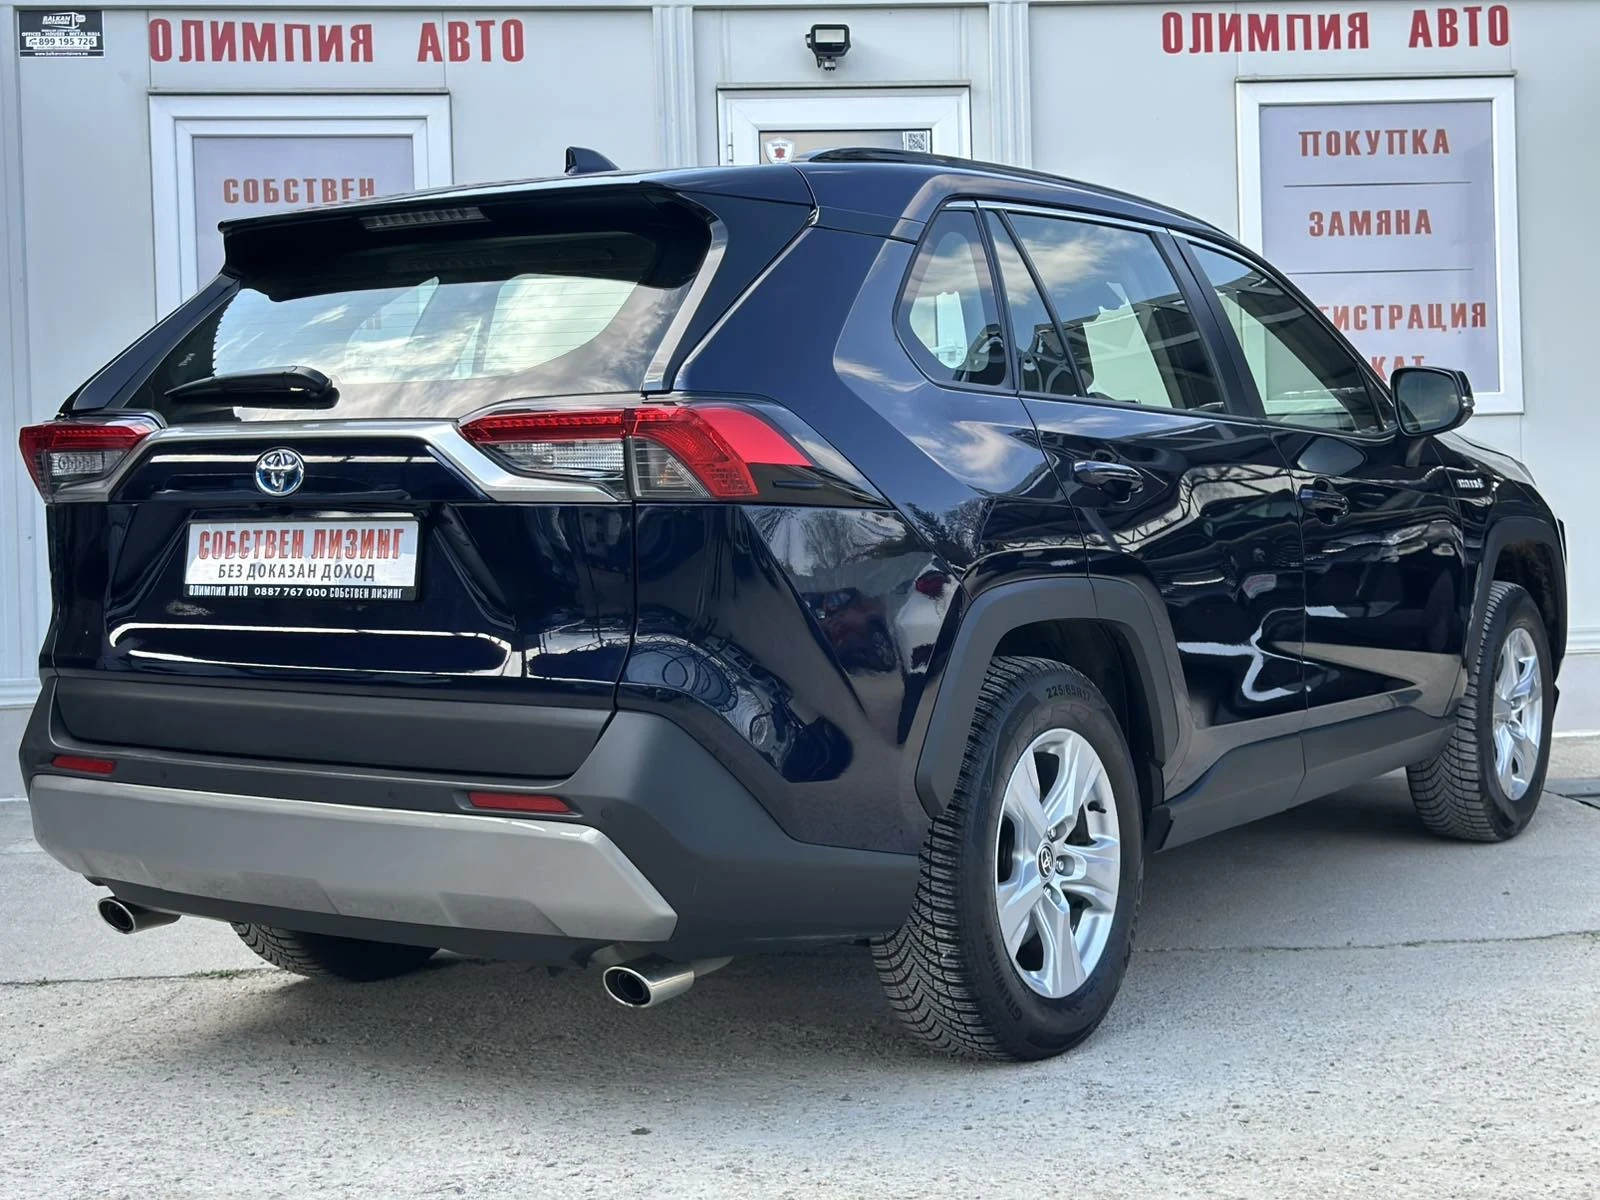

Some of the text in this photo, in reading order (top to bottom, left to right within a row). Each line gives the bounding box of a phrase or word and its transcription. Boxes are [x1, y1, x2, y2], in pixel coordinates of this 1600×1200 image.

[38, 38, 95, 46] 899 195 726
[149, 18, 525, 63] ОЛИМПИЯ АВТО
[1163, 4, 1510, 54] ОЛИМПИЯ АВТО
[1298, 128, 1450, 156] ПОКУПКА
[1309, 209, 1432, 237] ЗАМЯНА
[199, 528, 404, 560] СОБСТВЕН ЛИЗИНГ
[218, 564, 375, 582] БЕЗ ДОКАЗАН ДОХОД
[189, 586, 403, 599] ОЛИМПИЯ АВТО 0887 767 000 СОБСТВЕН ЛИЗИНГ
